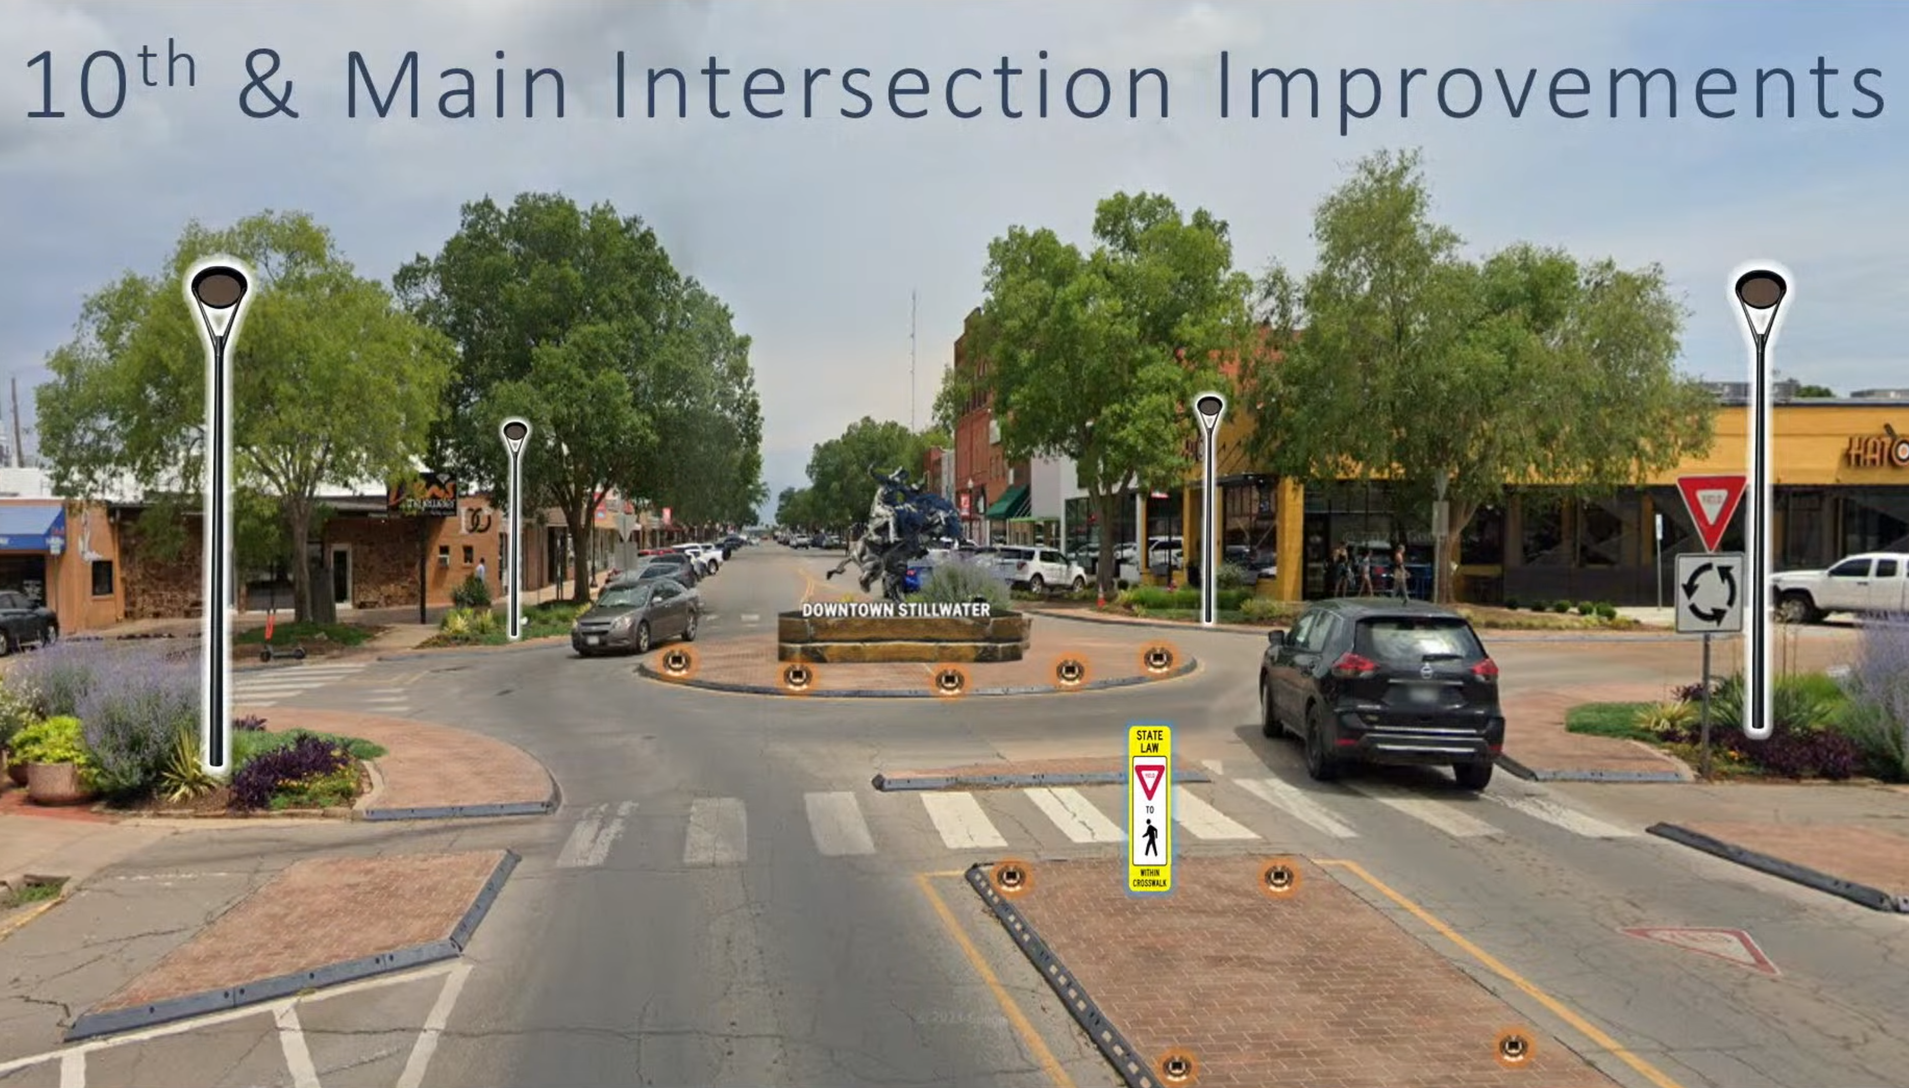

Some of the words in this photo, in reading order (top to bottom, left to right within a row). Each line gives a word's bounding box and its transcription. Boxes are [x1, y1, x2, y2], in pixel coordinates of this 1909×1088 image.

[1136, 730, 1164, 741] STATE
[1140, 743, 1160, 753] LAW
[1145, 805, 1155, 814] TO
[1140, 868, 1160, 877] WITHIN
[1132, 879, 1167, 888] CROSSWALK
